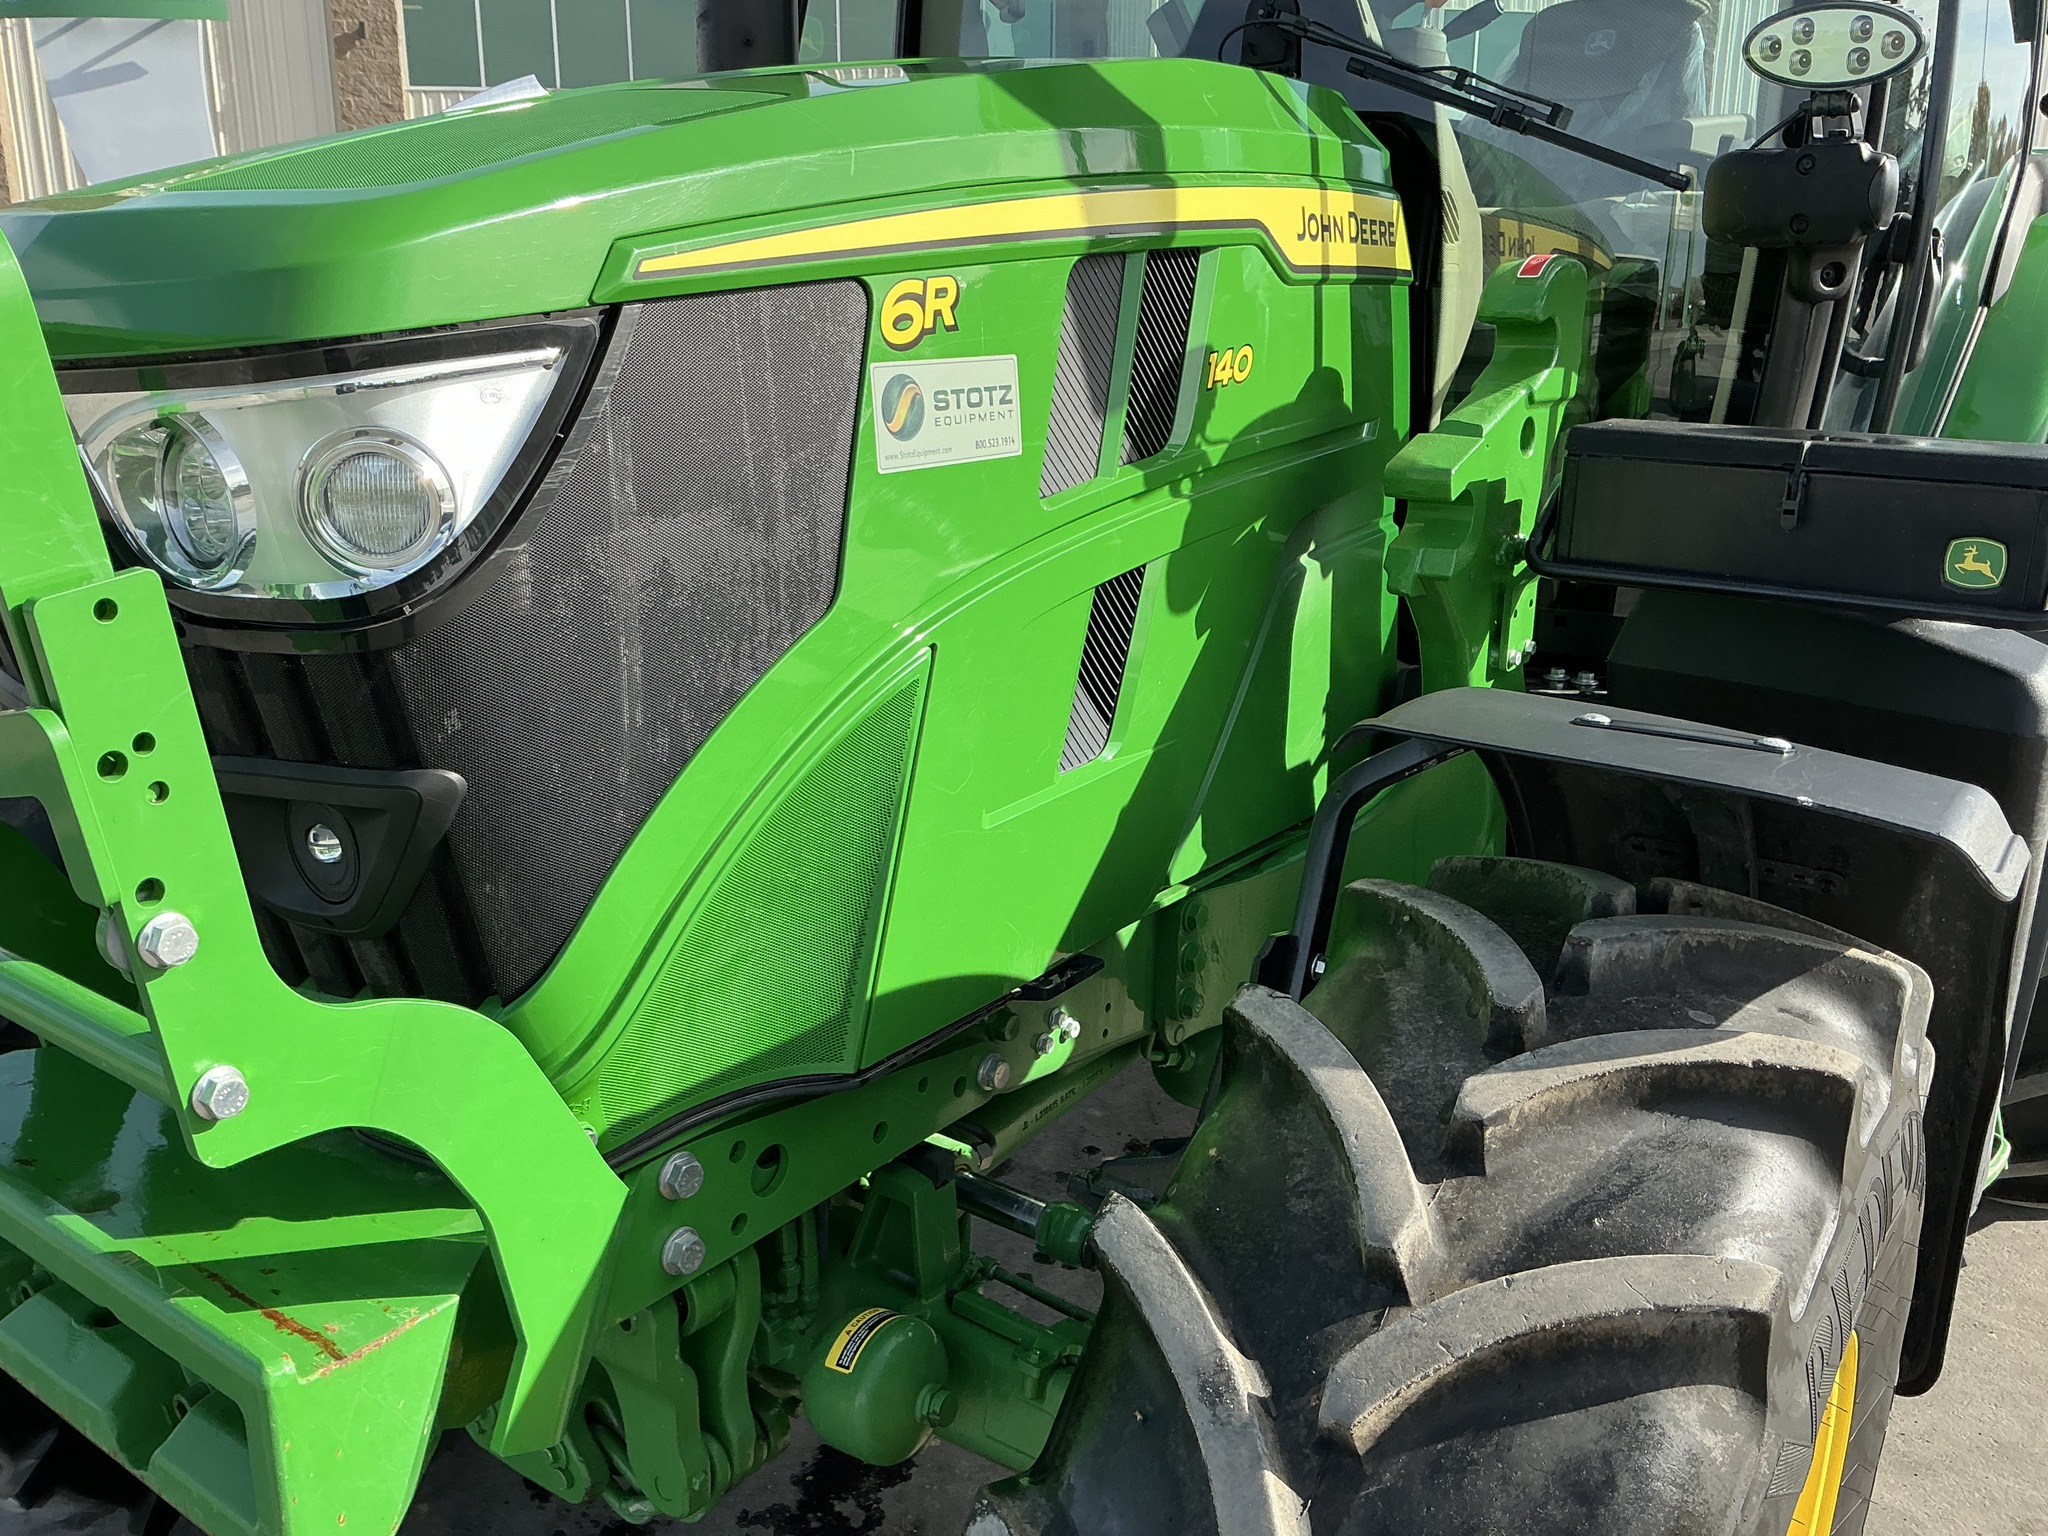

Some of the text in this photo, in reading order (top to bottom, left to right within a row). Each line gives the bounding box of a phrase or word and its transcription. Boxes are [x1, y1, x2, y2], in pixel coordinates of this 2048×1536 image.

[1297, 206, 1396, 247] JOHN DEERE
[880, 275, 959, 352] 6R
[1206, 343, 1254, 391] 140
[933, 384, 1013, 412] STOTZ
[934, 409, 1014, 428] EQUIPMENT
[884, 446, 953, 462] www.StotzEquipment.com
[975, 436, 1016, 450] 800.523.1914
